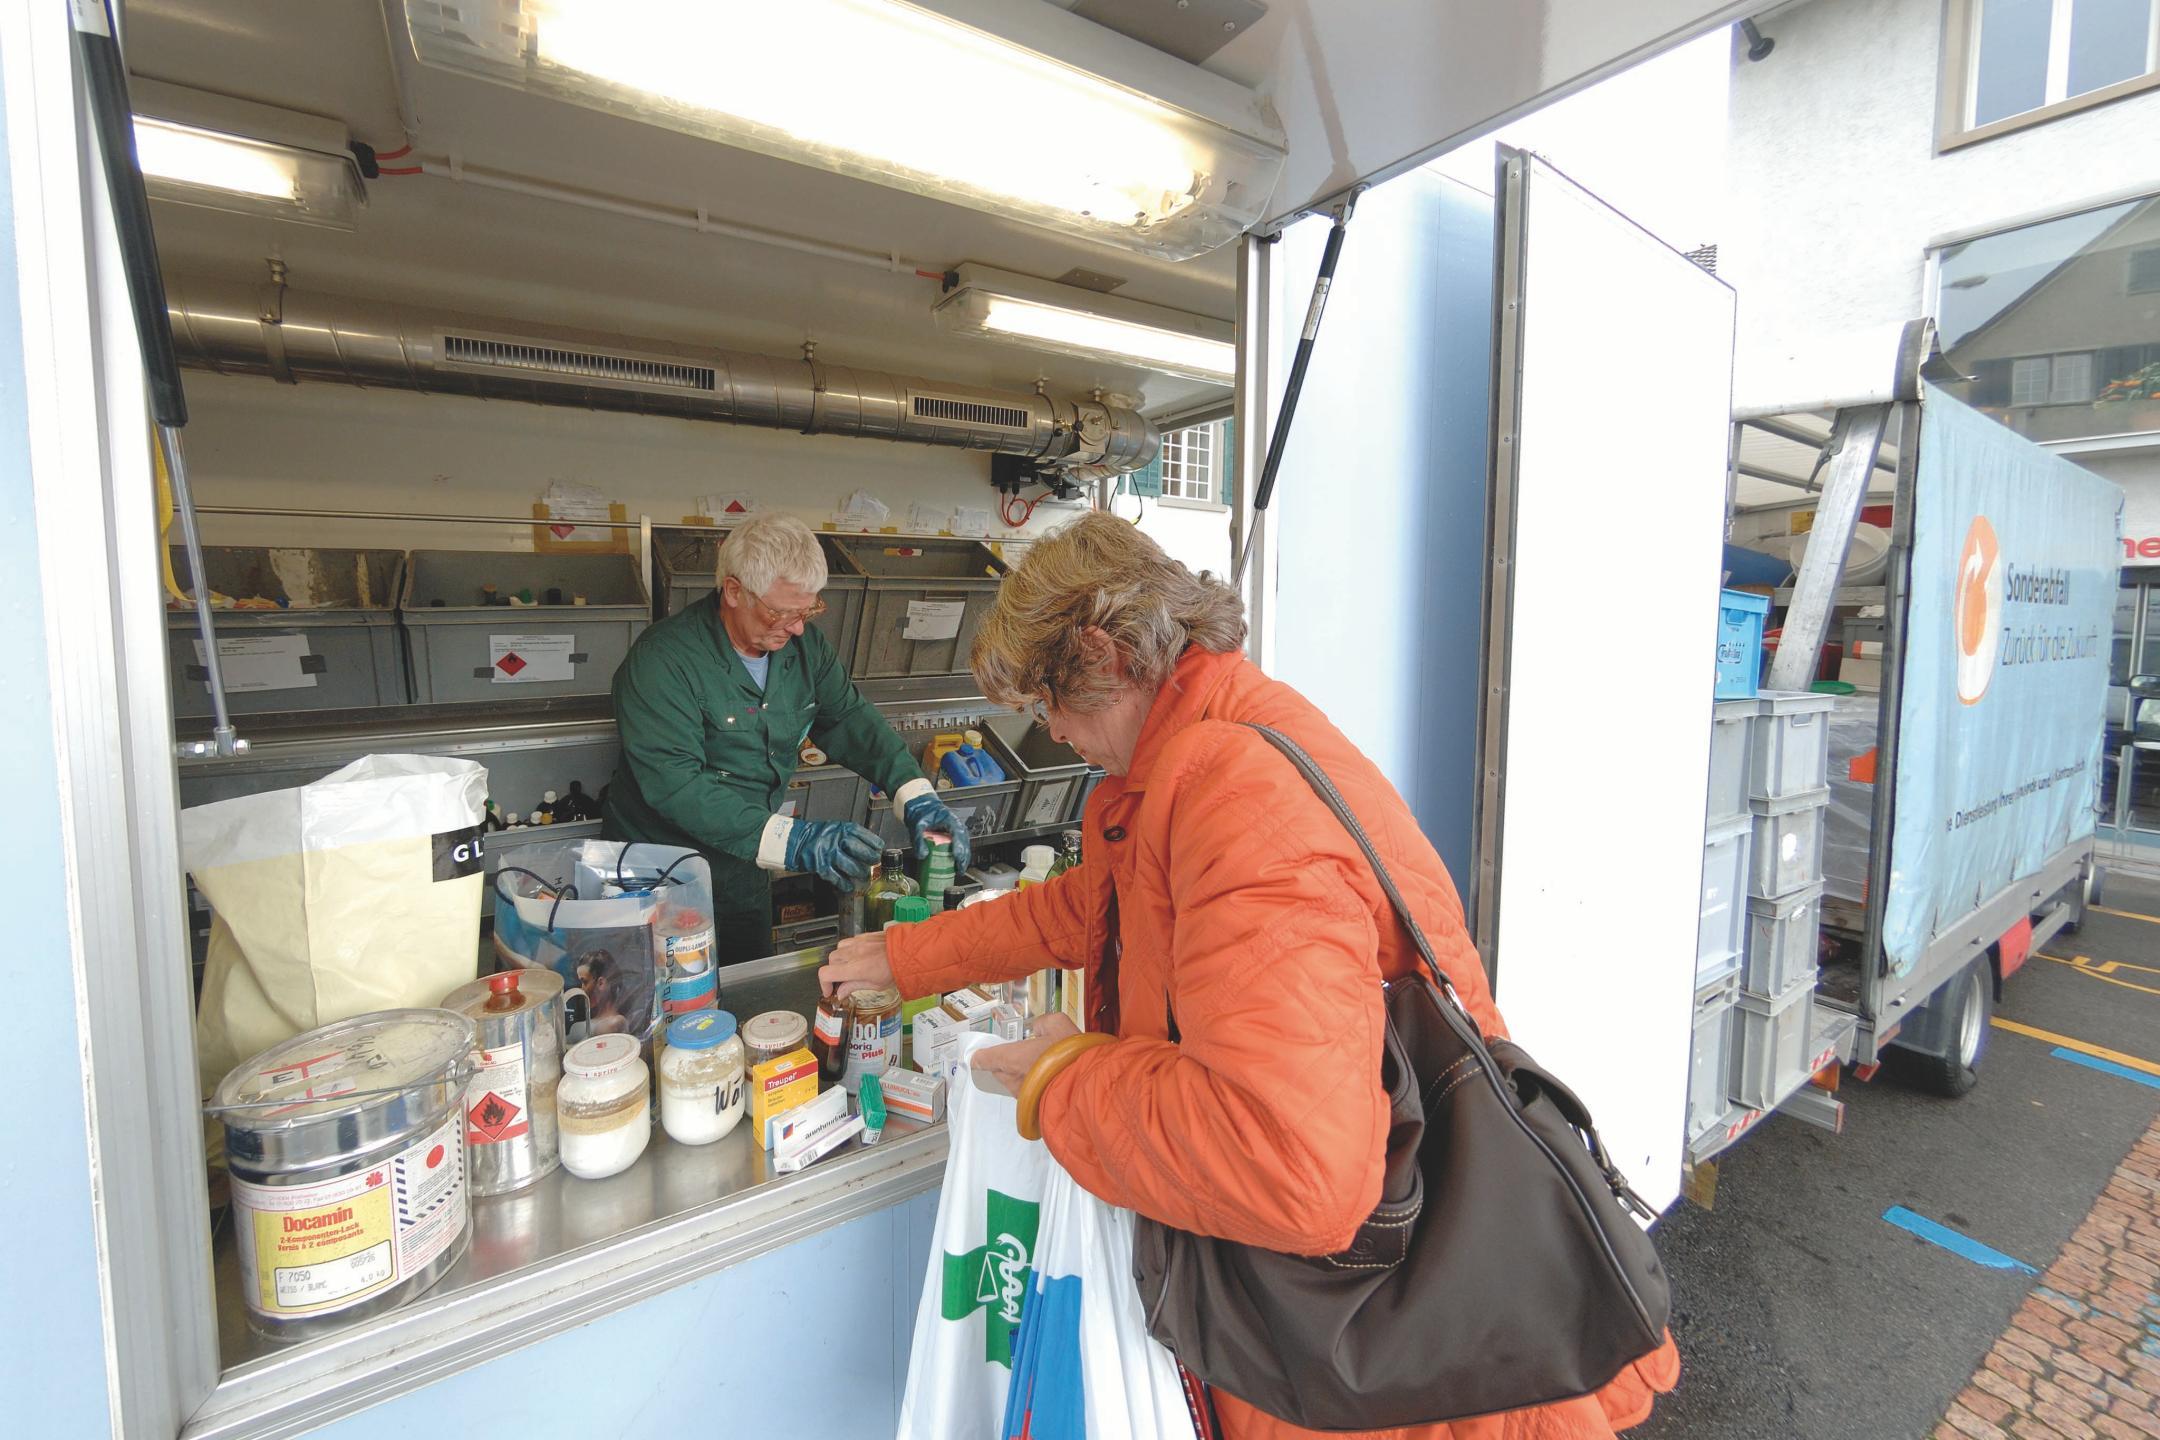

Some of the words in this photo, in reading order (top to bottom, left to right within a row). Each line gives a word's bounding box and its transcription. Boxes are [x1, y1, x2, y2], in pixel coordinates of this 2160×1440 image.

[2006, 562, 2071, 605] Sonderabfall
[861, 1048, 884, 1060] Plus
[767, 1072, 796, 1089] Treupel
[283, 1207, 354, 1233] Docamin
[280, 1222, 360, 1244] 2-Komponenten-Lack
[316, 1229, 364, 1248] composants
[288, 1271, 312, 1284] 7050
